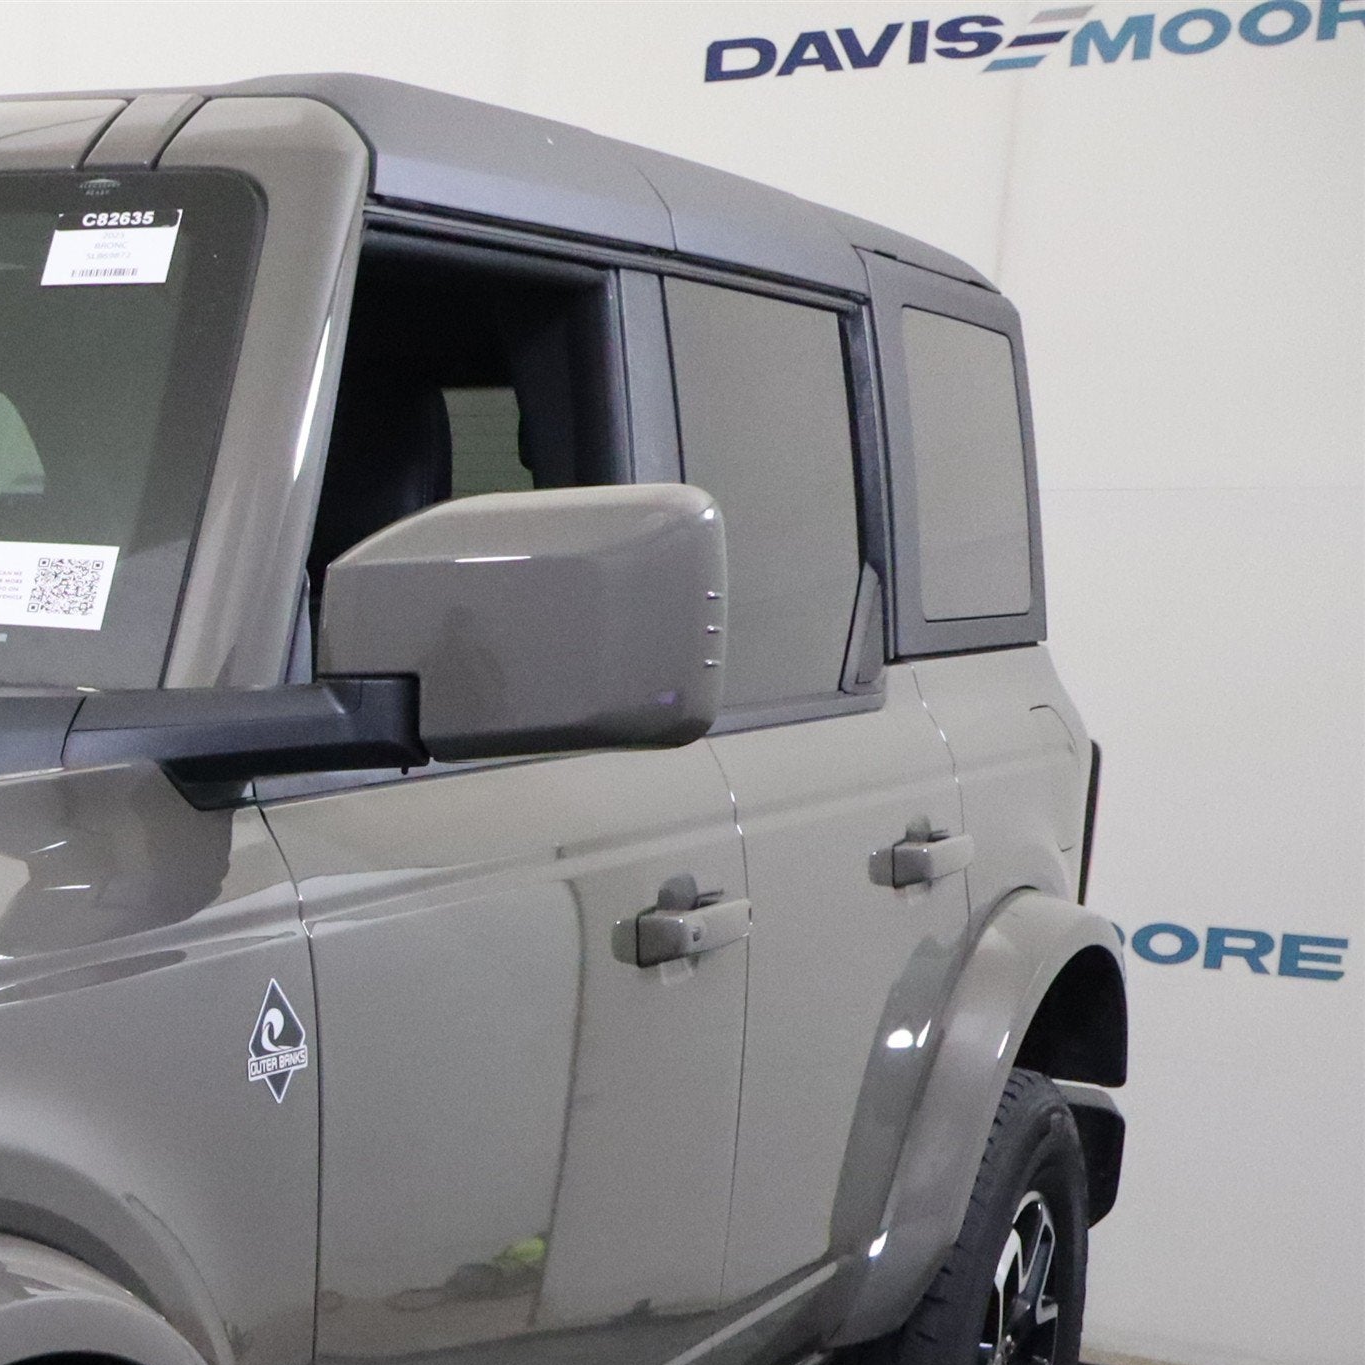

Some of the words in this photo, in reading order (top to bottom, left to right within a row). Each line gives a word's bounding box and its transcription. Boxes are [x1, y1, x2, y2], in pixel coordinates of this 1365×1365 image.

[703, 16, 1004, 84] DAVIS
[82, 210, 155, 227] C82635
[250, 1057, 278, 1076] OUTER
[278, 1050, 307, 1069] BANKS
